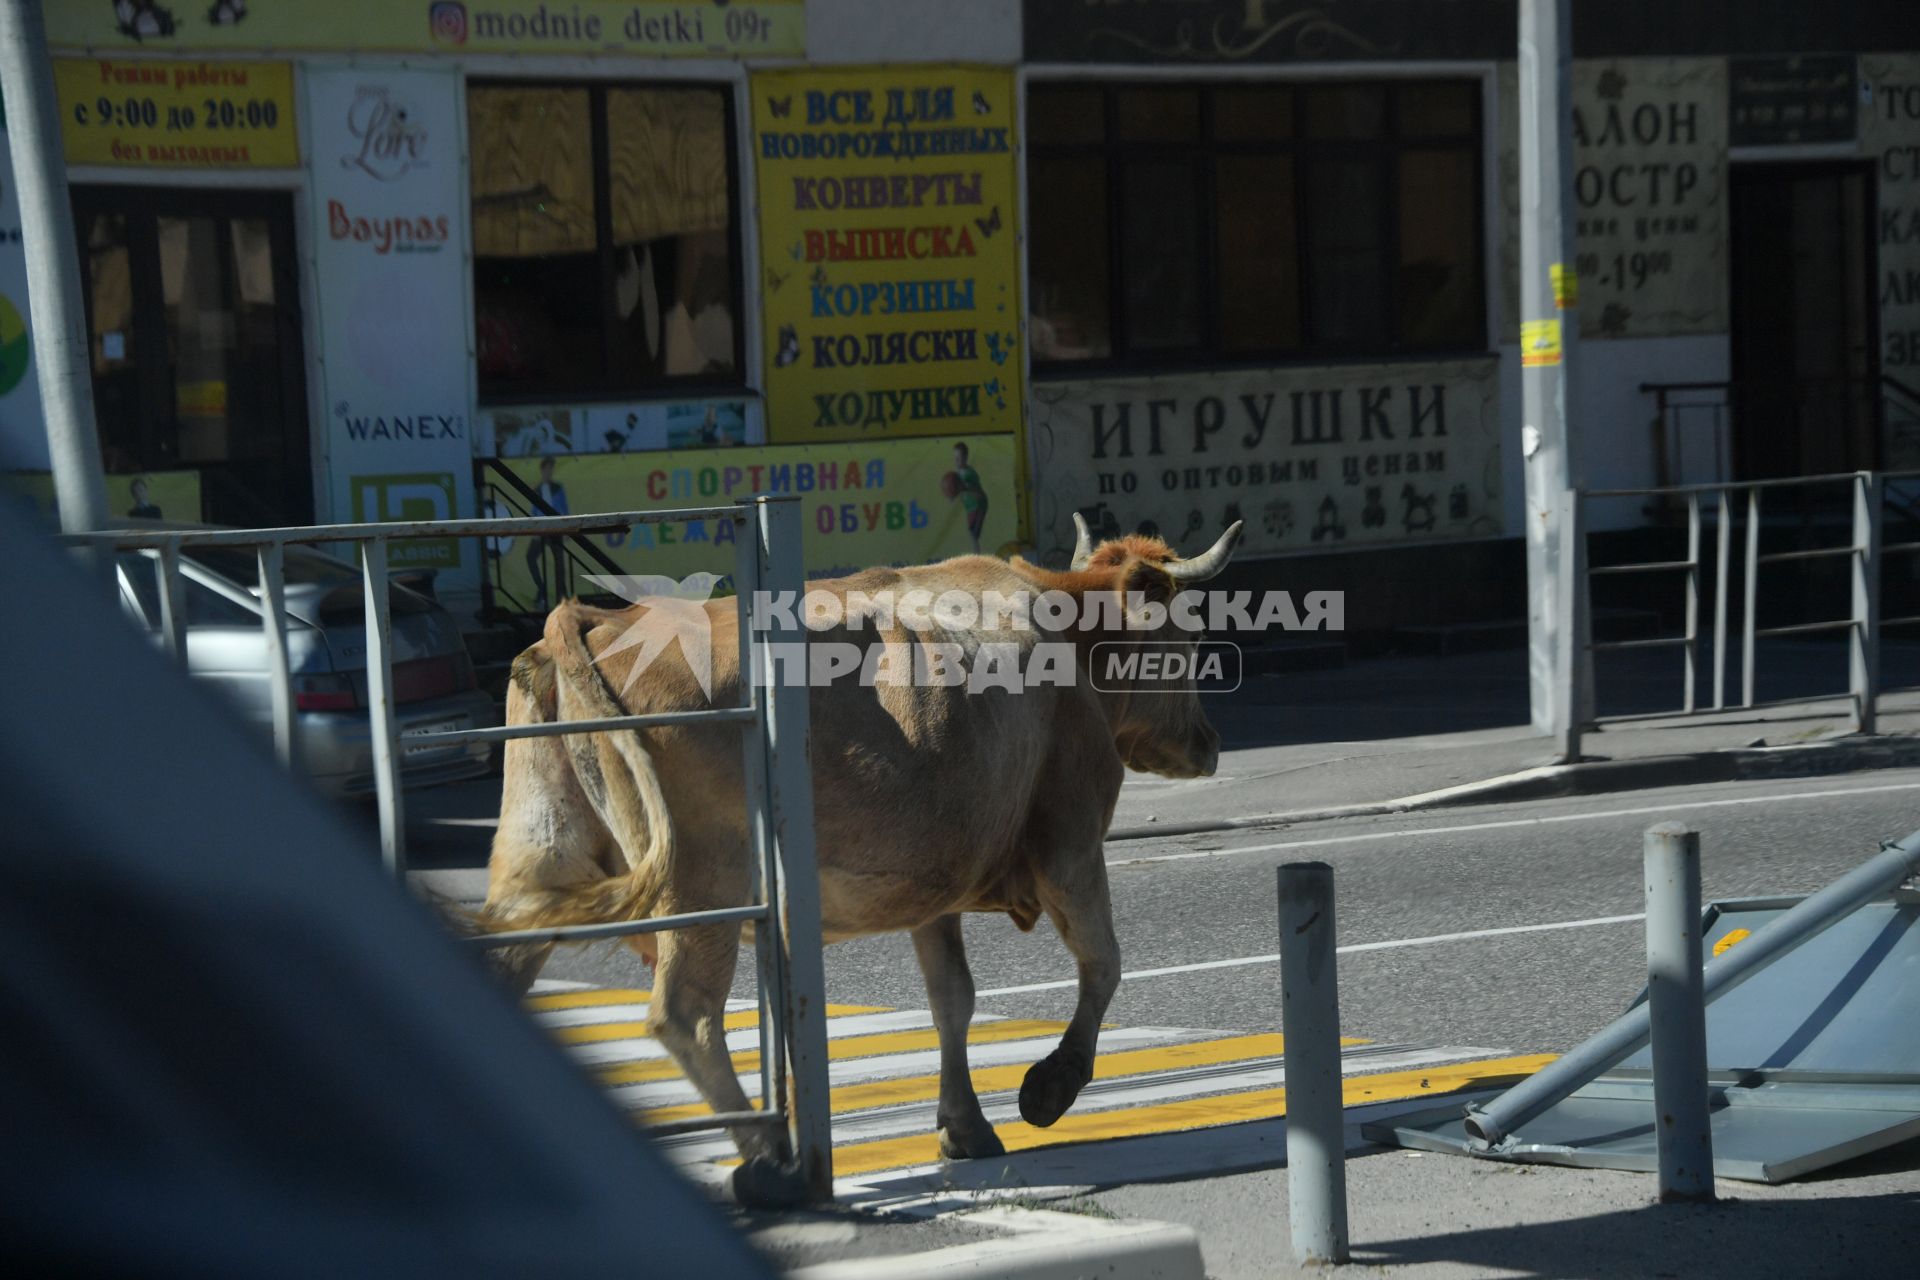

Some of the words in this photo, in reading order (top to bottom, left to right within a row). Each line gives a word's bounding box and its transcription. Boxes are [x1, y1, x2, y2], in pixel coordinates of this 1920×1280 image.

[96, 96, 157, 127] 9:00
[165, 103, 195, 131] до
[204, 98, 278, 129] 20:00
[805, 90, 874, 125] ВСЕ
[881, 87, 955, 127] ДЛЯ
[760, 127, 1009, 160] НОВОРОЖДЕННЫХ
[793, 172, 983, 210] КОНВЕРТЫ
[329, 200, 449, 254] Baynas
[803, 224, 976, 262] ВЫПИСКА
[810, 278, 976, 318] КОРЗИНЫ
[812, 328, 979, 368] КОЛЯСКИ
[814, 384, 981, 428] ХОДУНКИ
[1091, 384, 1449, 460] ИГРУШКИ
[345, 415, 457, 441] WANEX
[648, 458, 886, 500] СПОРТИВНАЯ
[1099, 471, 1138, 494] по
[1161, 457, 1319, 491] оптовым
[1343, 450, 1446, 485] ценам
[816, 500, 929, 534] ОБУВЬ
